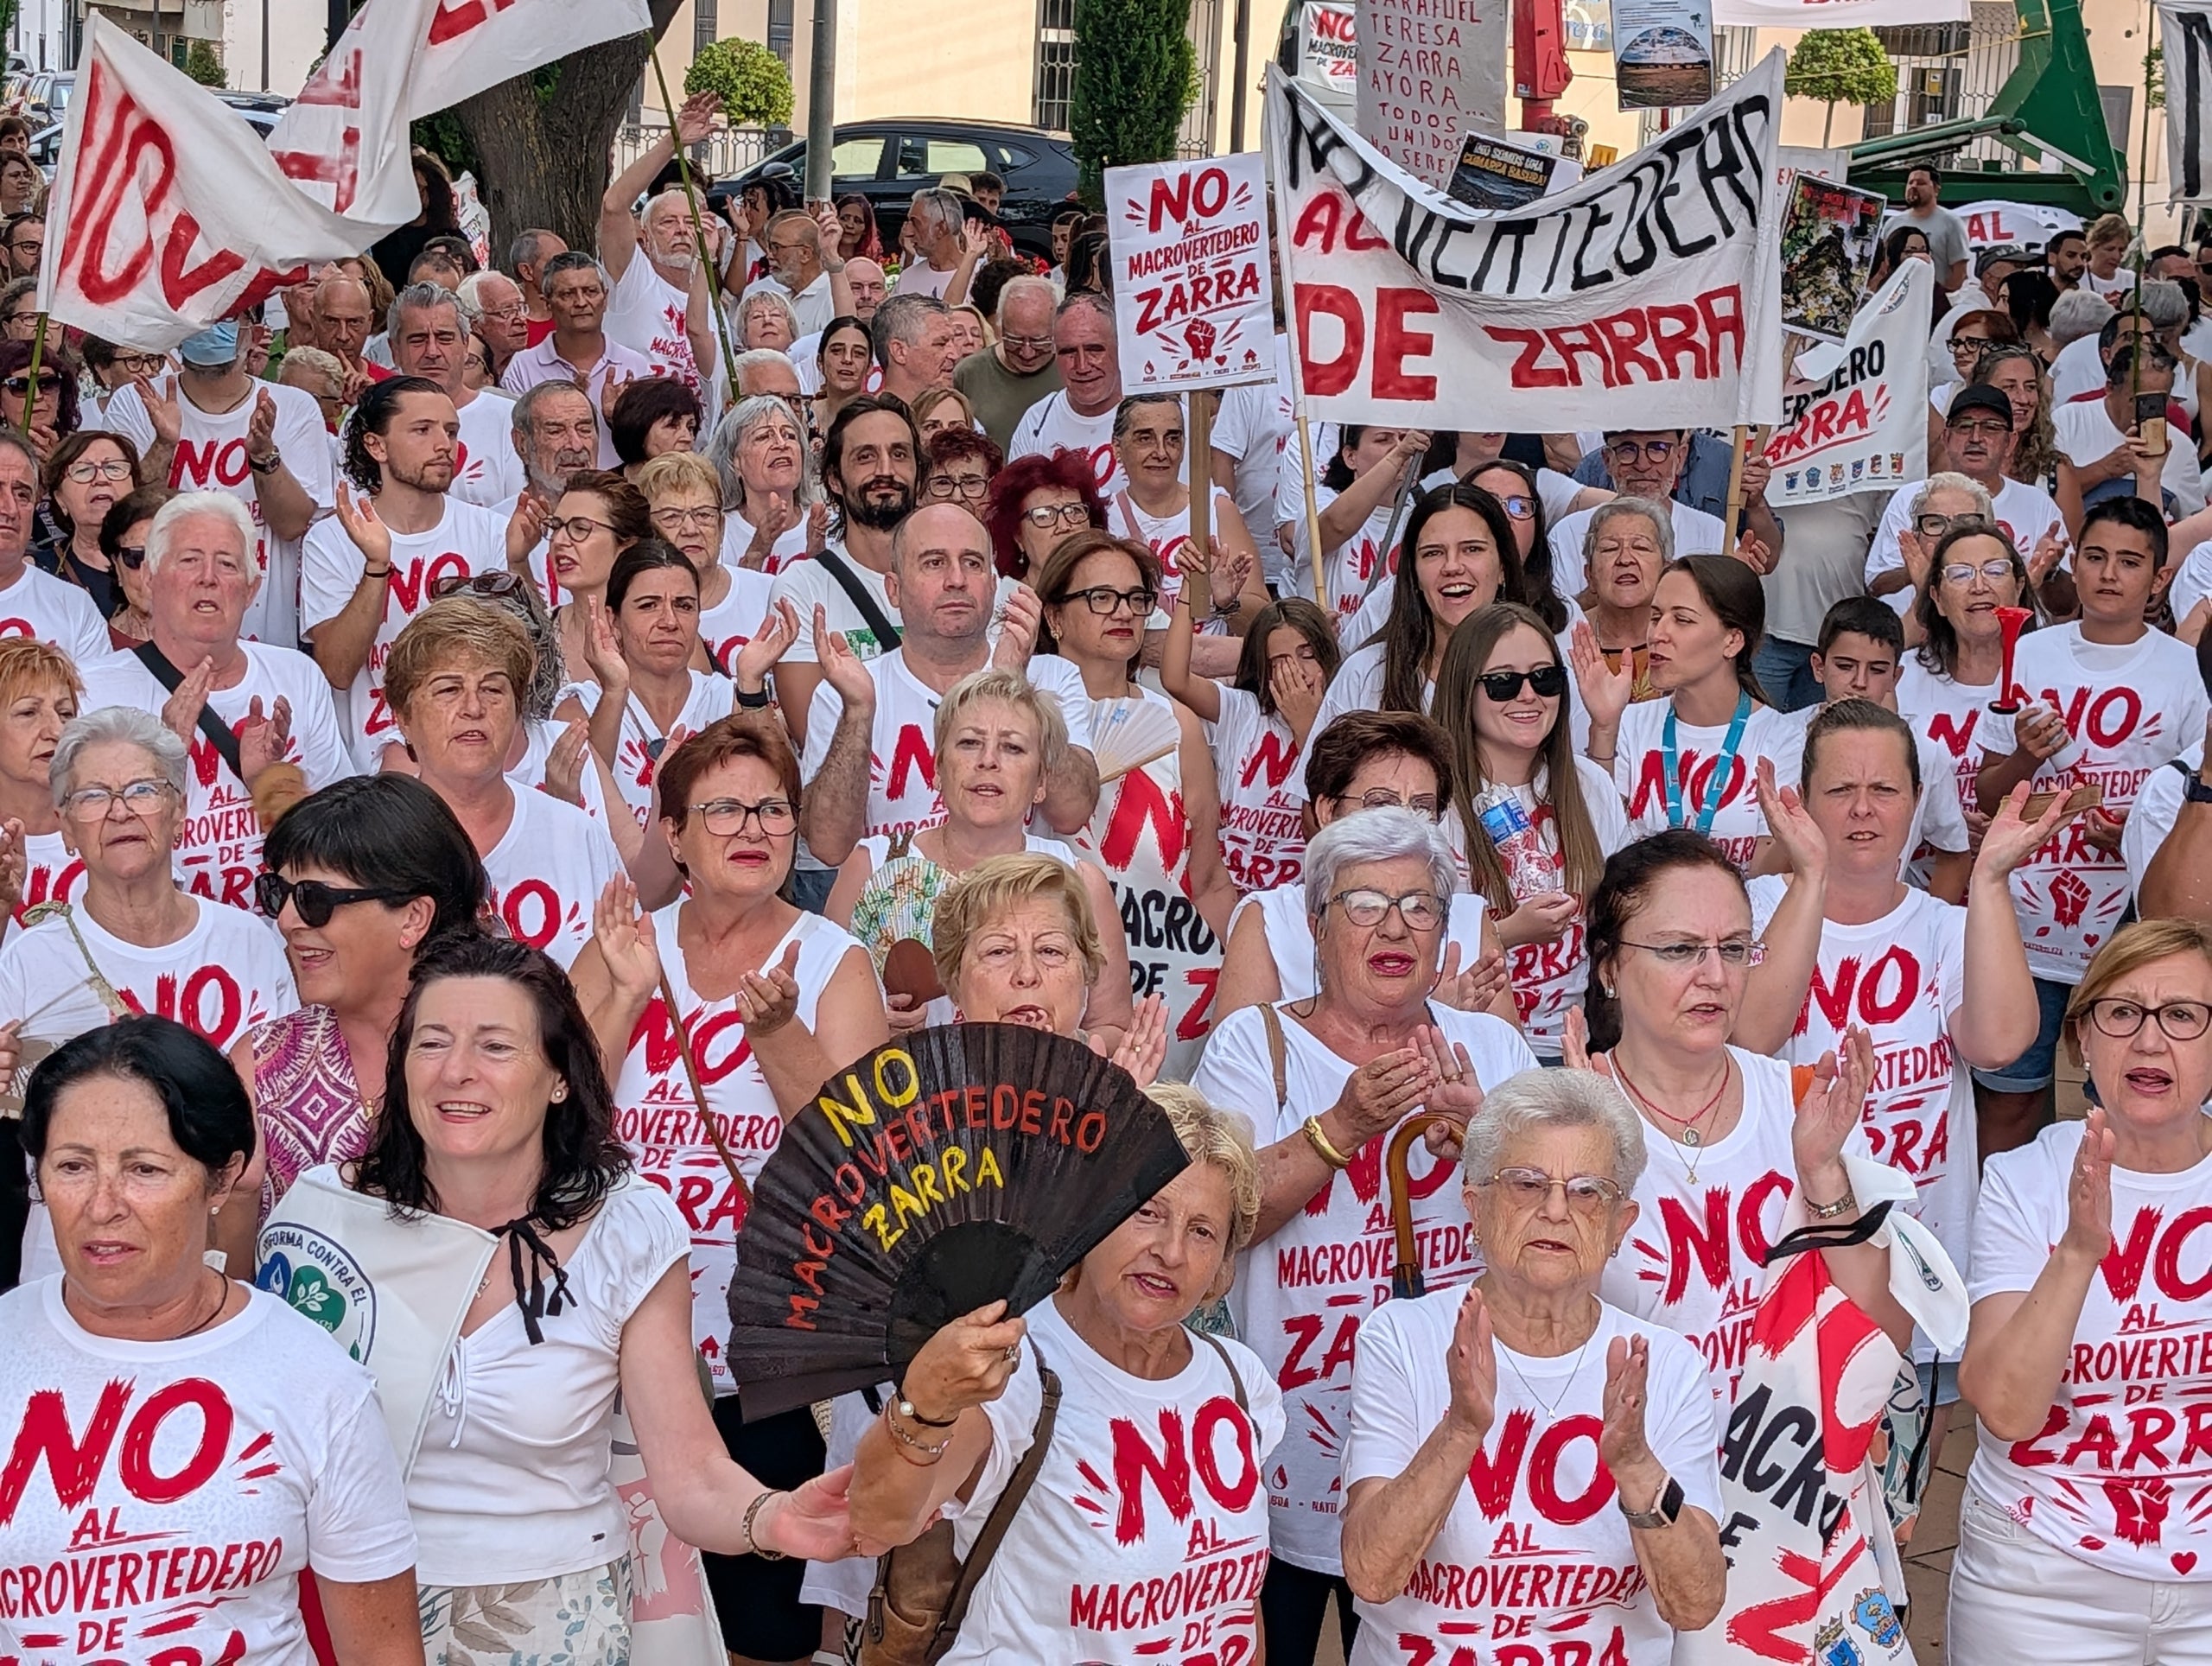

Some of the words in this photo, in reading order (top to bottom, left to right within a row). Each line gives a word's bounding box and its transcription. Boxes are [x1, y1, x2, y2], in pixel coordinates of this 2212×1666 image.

[1370, 13, 1461, 48] TERESA
[1376, 41, 1462, 82] ZARRA
[1378, 102, 1458, 133] TODOS
[1148, 167, 1229, 234] NO
[1183, 219, 1205, 238] AL
[1293, 192, 1389, 254] AL
[1967, 211, 2014, 242] AL
[1128, 221, 1260, 281] MACROVERTEDERO
[1187, 261, 1206, 278] DE
[1134, 262, 1261, 336] ZARRA
[1293, 283, 1440, 401] DE
[1483, 283, 1746, 390] ZARRA
[167, 436, 253, 489] NO
[208, 785, 238, 808] AL
[1266, 789, 1290, 808] AL
[218, 843, 246, 865] DE
[1254, 837, 1279, 855] DE
[1789, 944, 1922, 1037] NO
[626, 996, 755, 1085] NO
[645, 1078, 687, 1101] AL
[818, 1048, 920, 1148] NO
[640, 1147, 677, 1169] DE
[786, 1084, 1107, 1331] MACROVERTEDERO
[862, 1145, 1005, 1254] ZARRA
[307, 1240, 356, 1288] CONTRA
[351, 1287, 367, 1307] EL
[1720, 1277, 1760, 1318] AL
[2120, 1302, 2165, 1331] AL
[2124, 1383, 2168, 1407] DE
[0, 1374, 234, 1531] NO
[1109, 1395, 1260, 1548] NO
[70, 1506, 128, 1547] AL
[1187, 1517, 1226, 1556] AL
[1491, 1522, 1541, 1554] AL
[0, 1536, 283, 1621] CROVERTEDERO
[77, 1616, 129, 1656] DE
[1179, 1612, 1217, 1653] DE
[1491, 1614, 1537, 1640] DE
